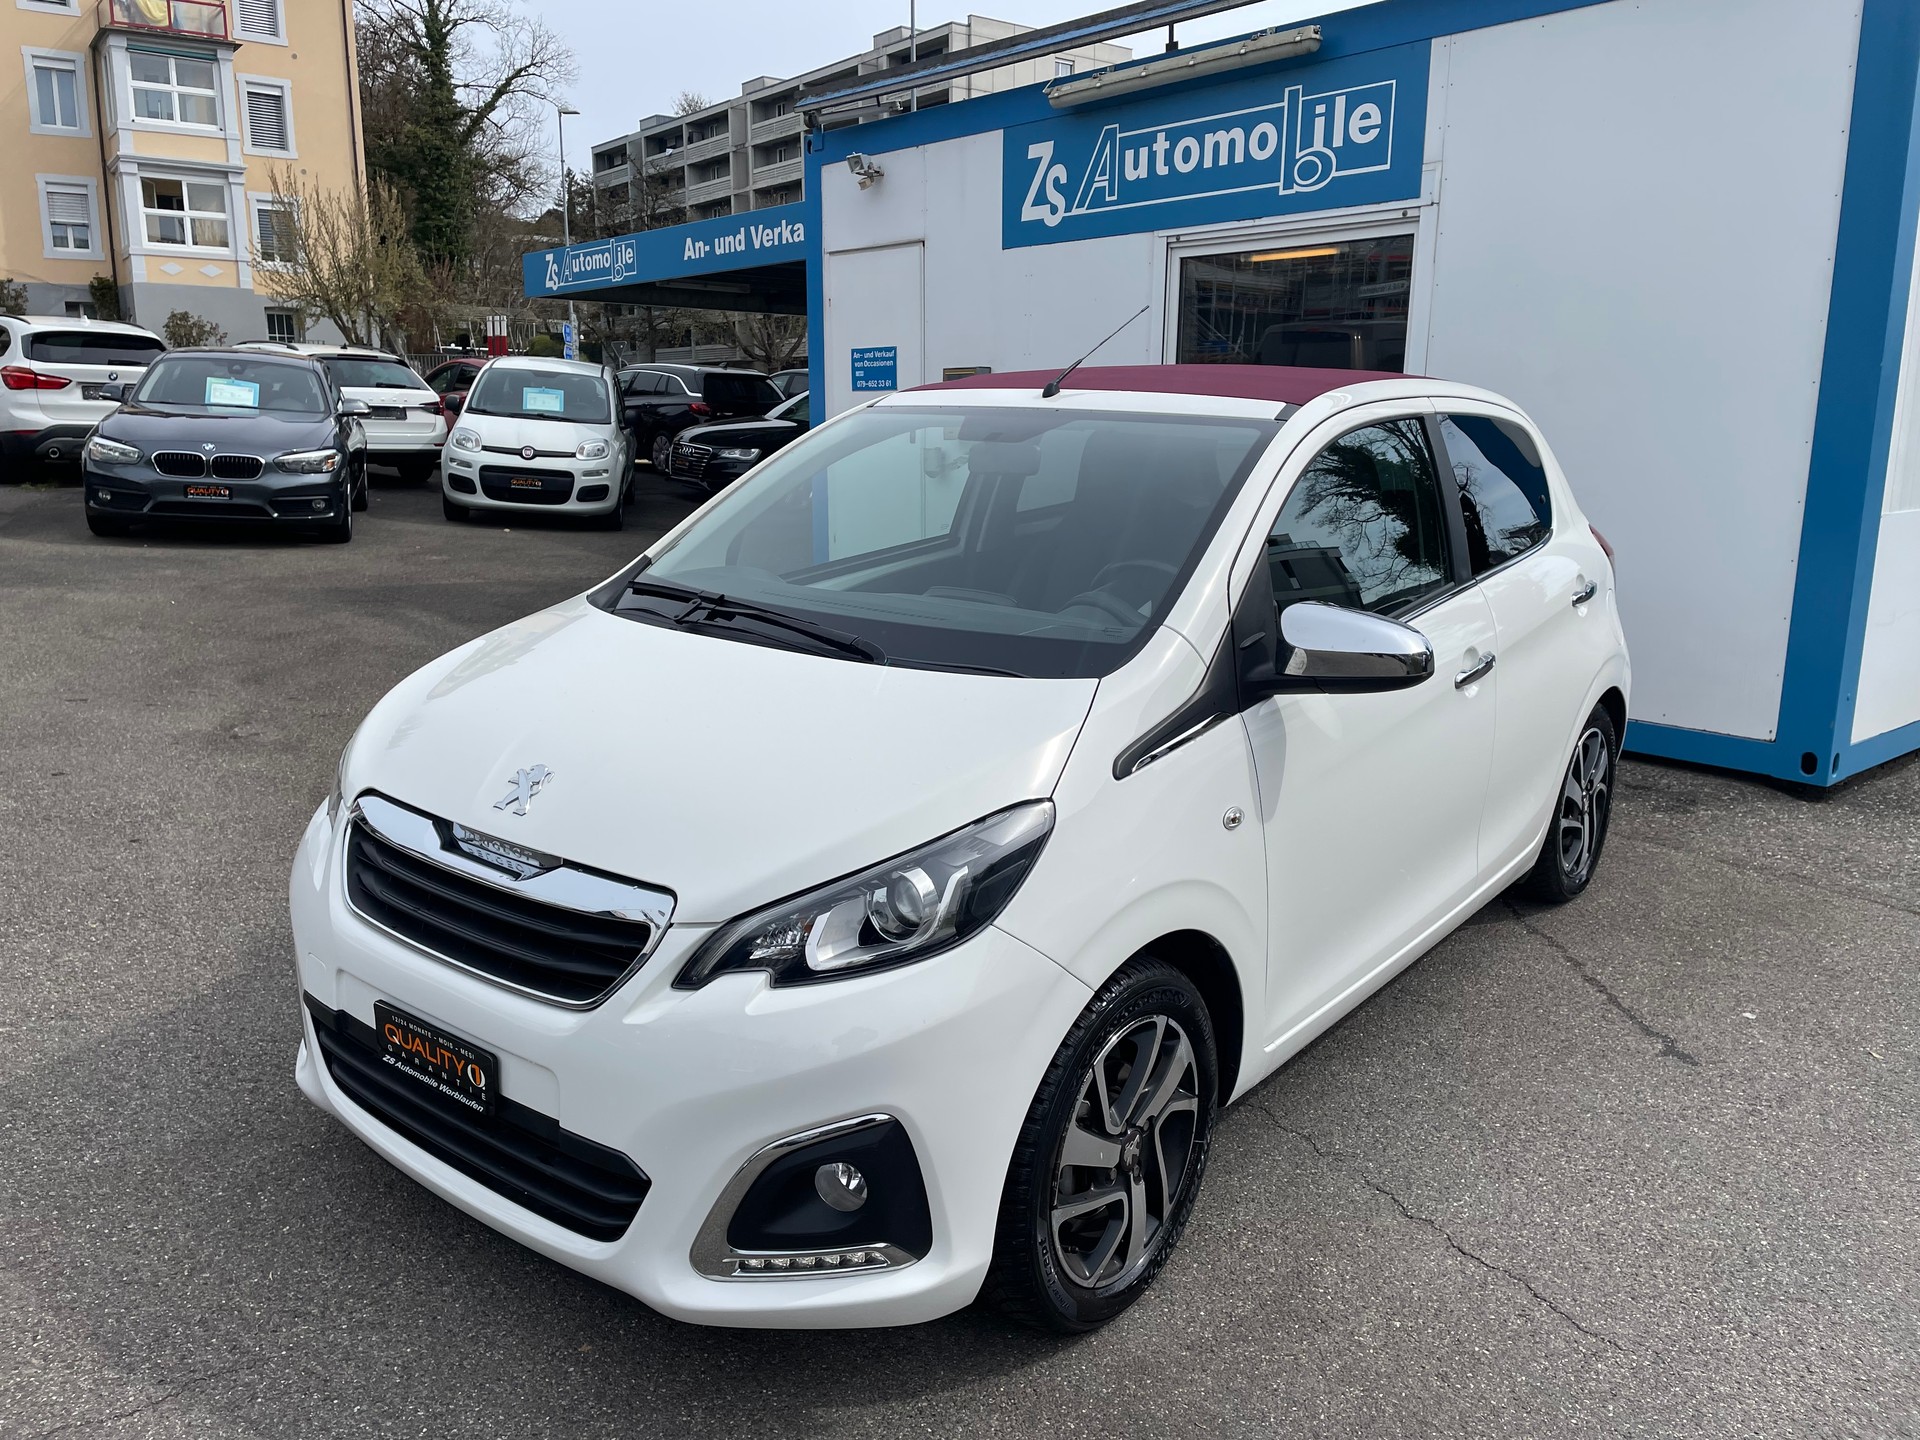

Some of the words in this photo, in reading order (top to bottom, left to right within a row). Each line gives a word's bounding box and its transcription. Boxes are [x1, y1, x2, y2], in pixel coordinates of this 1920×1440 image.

[1070, 84, 1383, 214] Automobile
[560, 238, 634, 285] Automobile
[683, 237, 710, 261] An-
[714, 226, 746, 256] und
[874, 349, 895, 357] Verkauf
[408, 1022, 432, 1039] MONATE
[438, 1037, 454, 1049] MOIS
[460, 1047, 475, 1060] MESI
[382, 1054, 396, 1065] ZS
[394, 1060, 439, 1088] Automobile
[438, 1083, 484, 1112] Worblaufen
